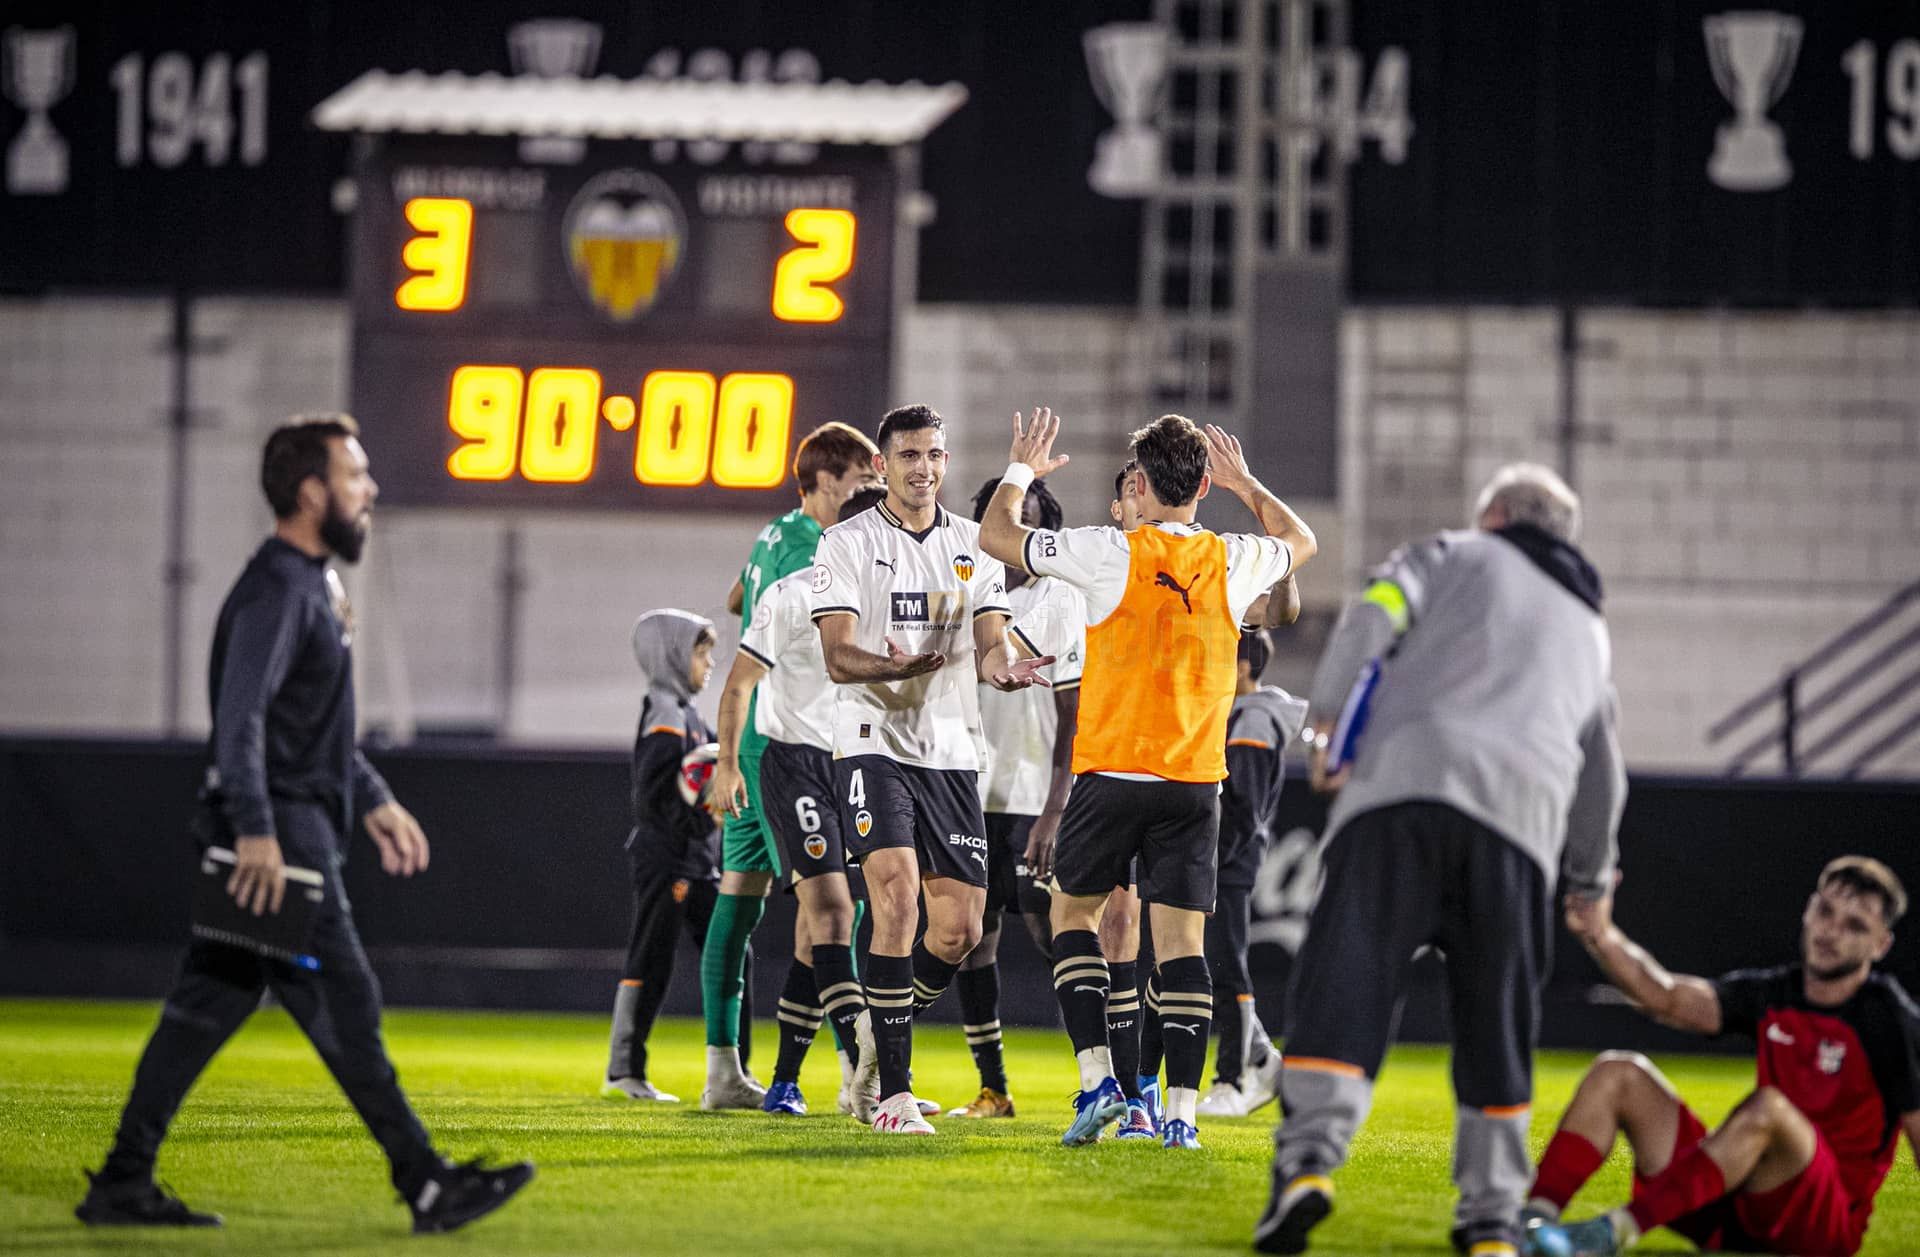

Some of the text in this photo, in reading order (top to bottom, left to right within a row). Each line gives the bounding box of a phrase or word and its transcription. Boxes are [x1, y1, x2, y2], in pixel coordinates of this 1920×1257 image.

[110, 51, 268, 166] 1941
[395, 196, 473, 311] 3
[772, 208, 857, 322] 2
[895, 599, 922, 616] TM
[892, 623, 905, 632] TM
[848, 768, 866, 809] 4
[795, 796, 821, 833] 6
[884, 1015, 911, 1025] VCF
[1108, 1020, 1133, 1030] VCF
